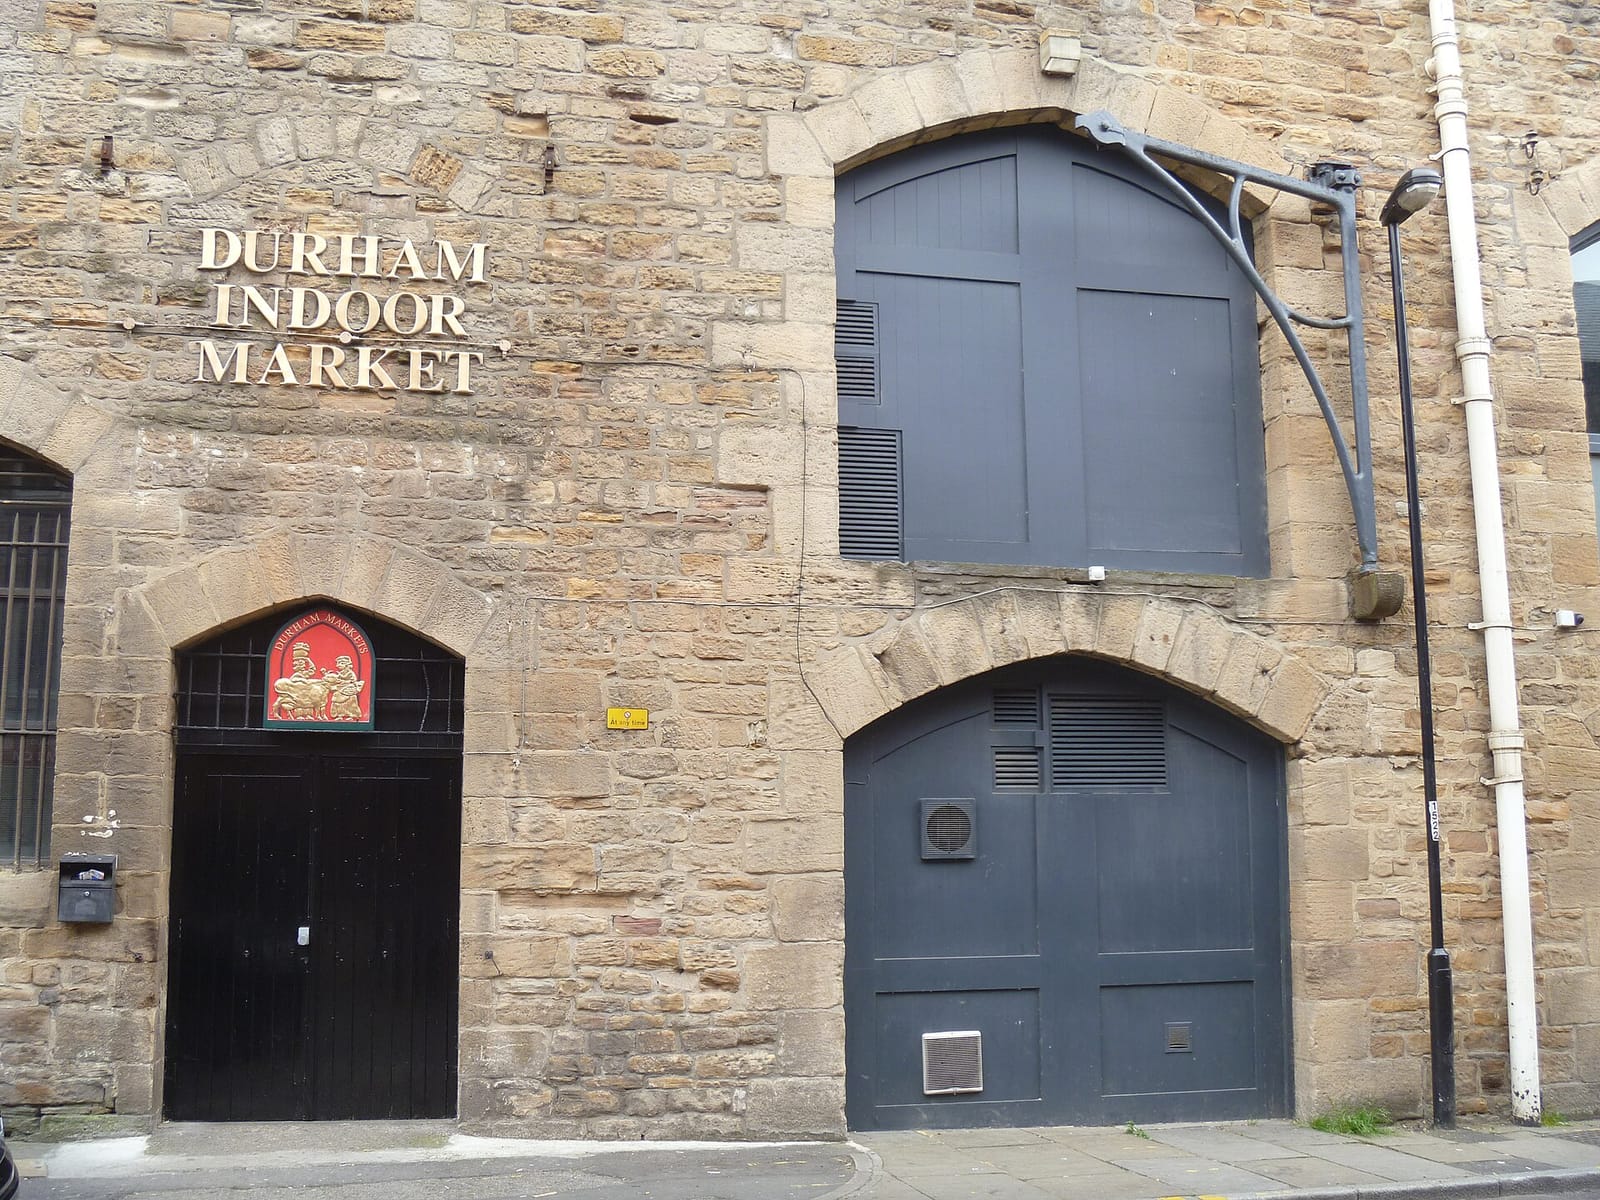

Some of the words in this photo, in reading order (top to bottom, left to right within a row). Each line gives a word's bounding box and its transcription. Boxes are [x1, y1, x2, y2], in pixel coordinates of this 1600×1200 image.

[197, 228, 490, 284] DURHAM
[210, 284, 469, 336] INDOOR
[193, 341, 484, 395] MARKET
[275, 613, 320, 651] DURHAM
[325, 613, 369, 654] MARKETS
[1431, 802, 1440, 840] 1522
